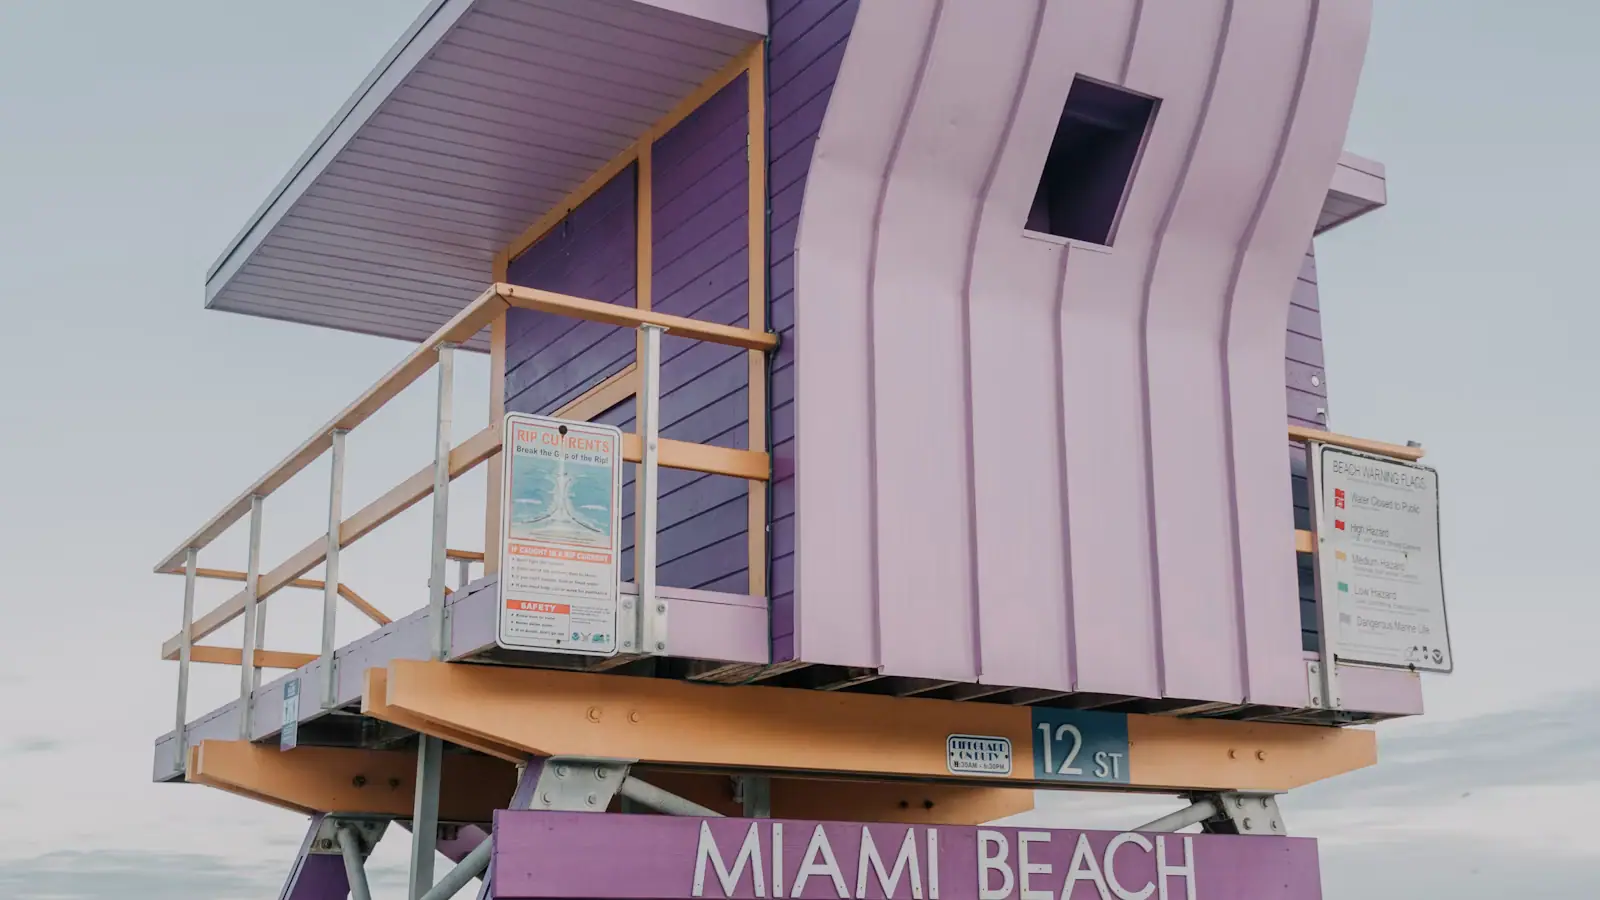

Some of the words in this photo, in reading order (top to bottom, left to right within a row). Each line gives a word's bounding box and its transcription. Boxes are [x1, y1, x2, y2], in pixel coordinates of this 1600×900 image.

[517, 429, 537, 443] RIP
[516, 445, 538, 455] Break
[540, 448, 552, 457] the
[580, 454, 592, 462] the
[1333, 460, 1360, 476] BEACH
[1362, 465, 1399, 485] WARNING
[1400, 473, 1428, 490] FLAGS
[1352, 492, 1369, 505] Water
[1371, 496, 1393, 509] Closed
[1394, 501, 1401, 510] to
[1401, 502, 1421, 514] Public
[1350, 523, 1365, 535] High
[1354, 584, 1369, 596] Low
[1371, 589, 1397, 600] Hazard
[520, 602, 557, 612] SAFETY
[1356, 615, 1393, 630] Dangerous
[952, 740, 1006, 752] LIFEGUARD
[1037, 722, 1083, 775] 12
[1094, 751, 1123, 779] ST
[959, 751, 973, 760] ON
[974, 751, 1000, 761] DUTY
[691, 820, 939, 899] MIAMI
[977, 829, 1197, 900] BEACH
